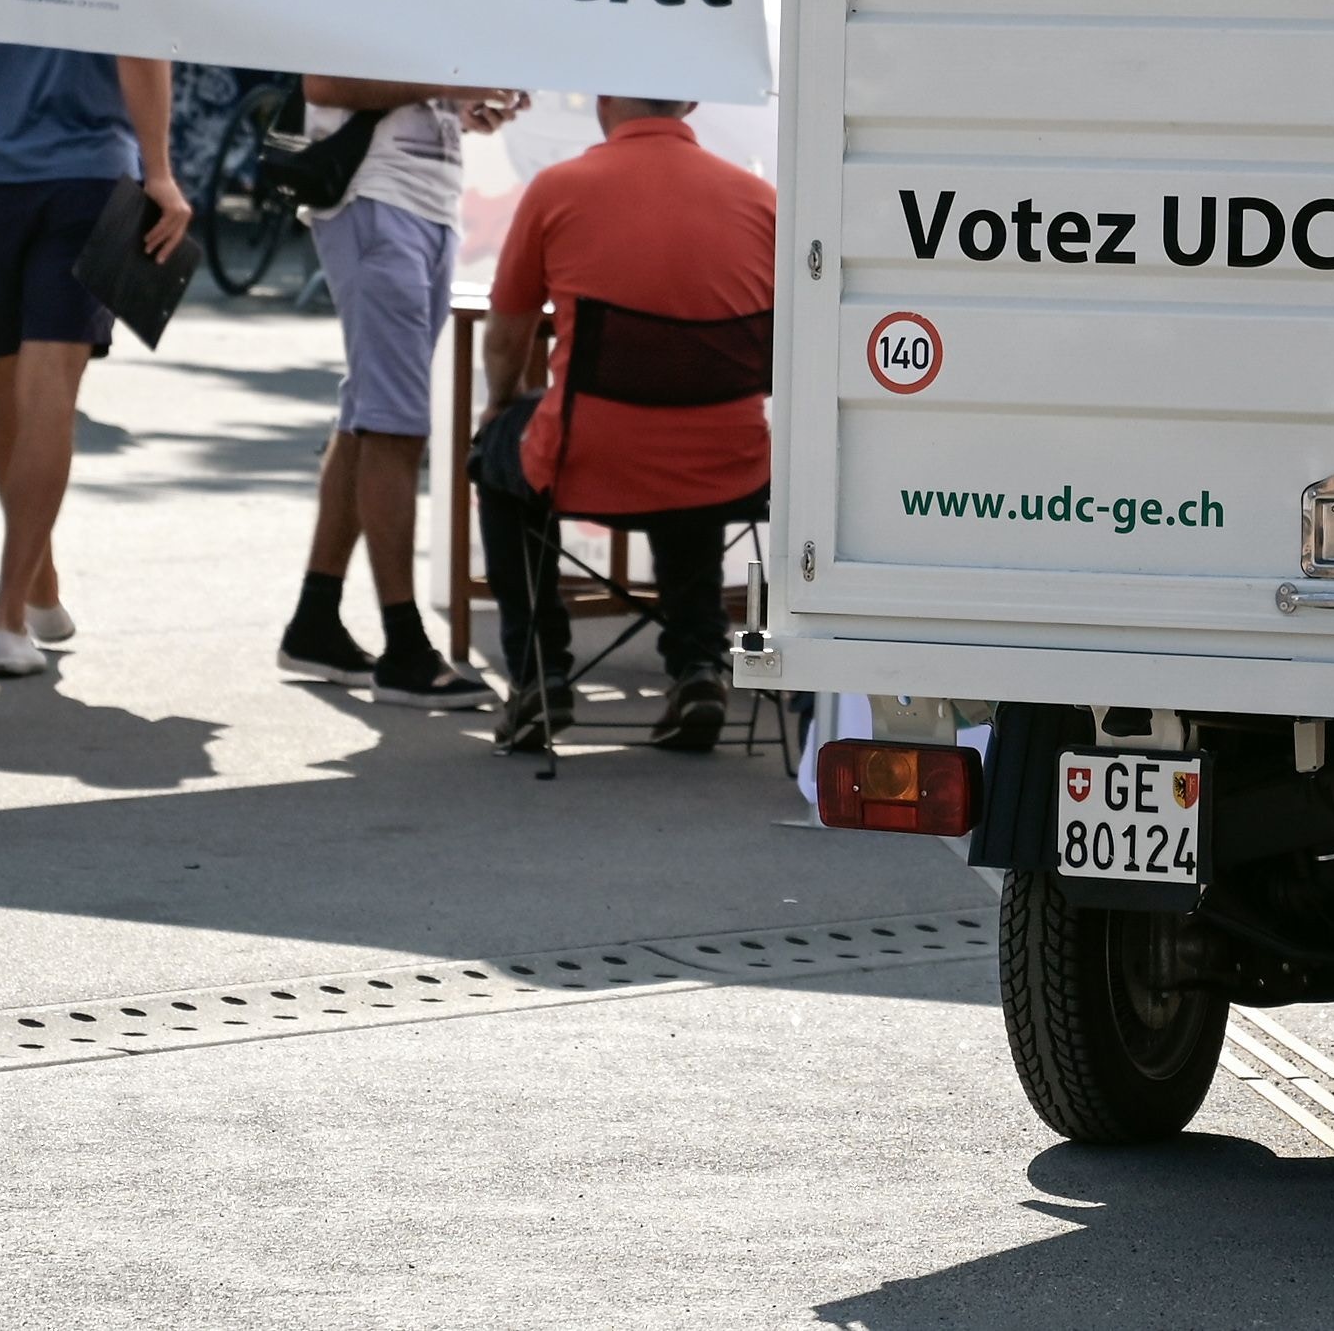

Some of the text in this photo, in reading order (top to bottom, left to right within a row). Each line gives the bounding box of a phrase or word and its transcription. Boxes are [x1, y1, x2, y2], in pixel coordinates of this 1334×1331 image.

[898, 189, 1136, 266] Votez
[880, 336, 929, 370] 140
[900, 485, 1224, 534] www.udc-ge.ch
[1105, 762, 1160, 813] GE
[1065, 820, 1196, 876] 80124
